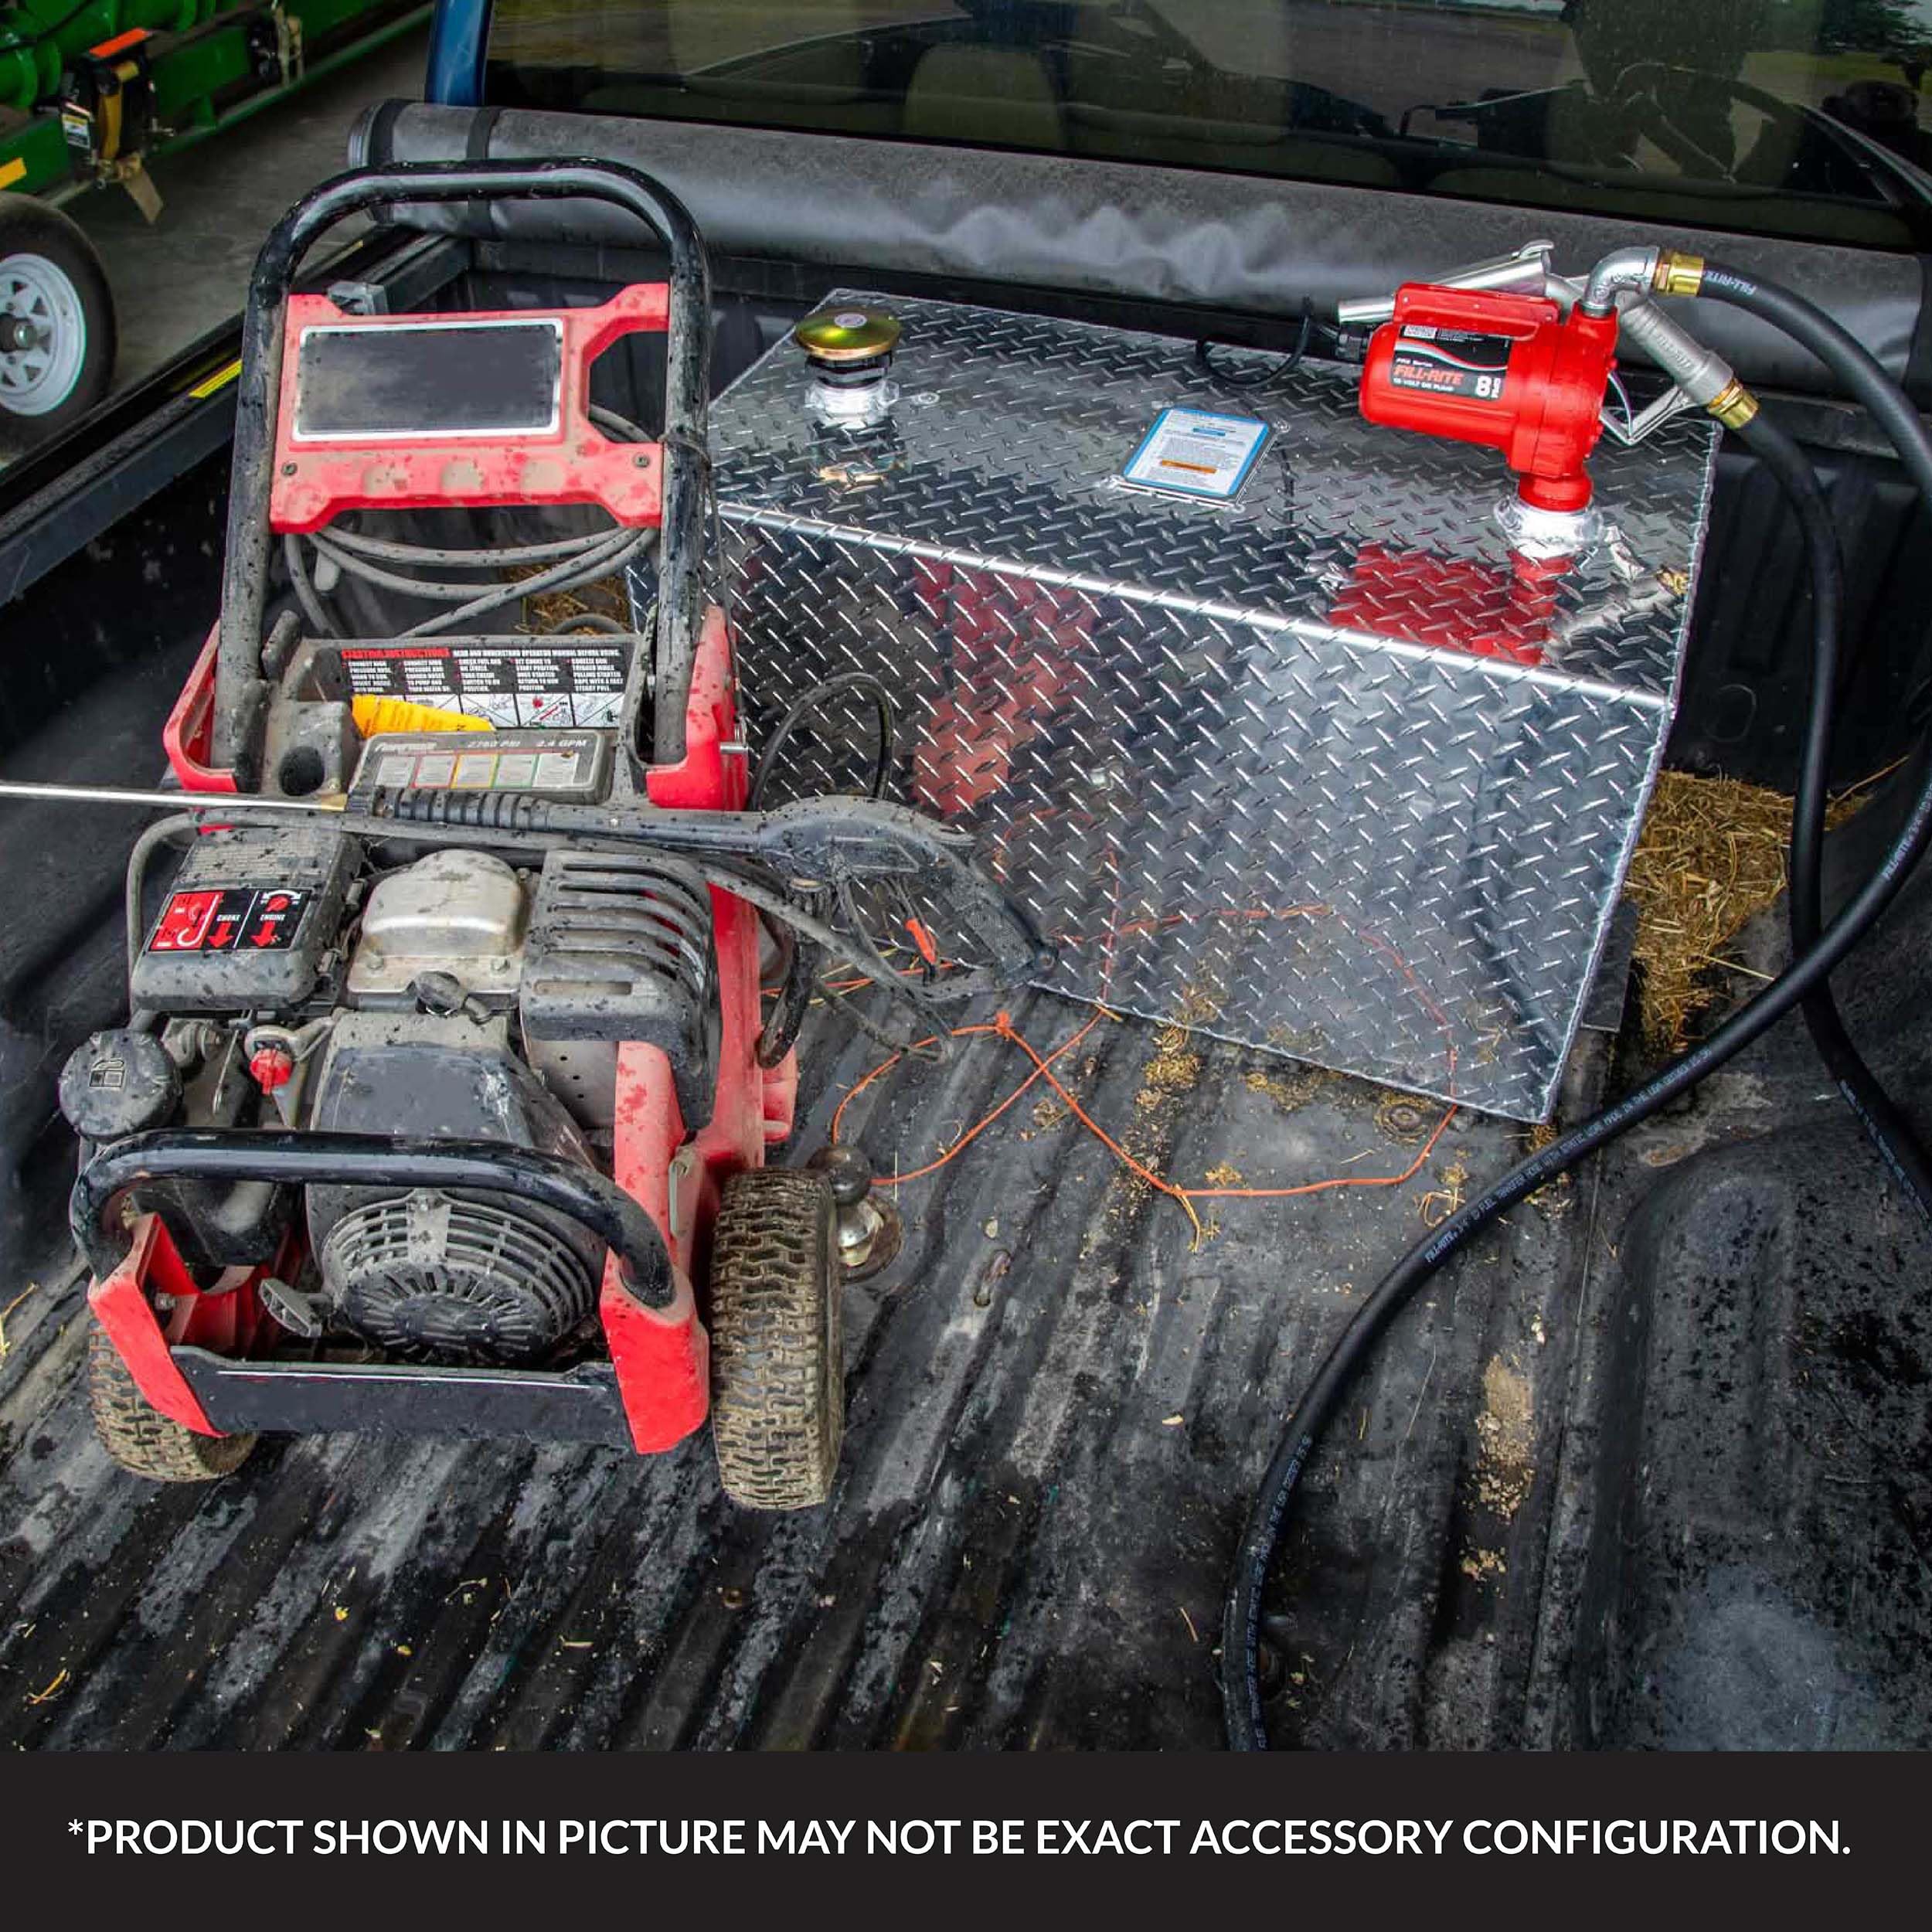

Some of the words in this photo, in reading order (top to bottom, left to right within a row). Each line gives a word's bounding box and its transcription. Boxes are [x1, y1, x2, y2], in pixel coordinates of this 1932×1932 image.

[1393, 364, 1465, 385] FILL-RITE
[1475, 375, 1492, 397] 8
[558, 739, 589, 749] GPM
